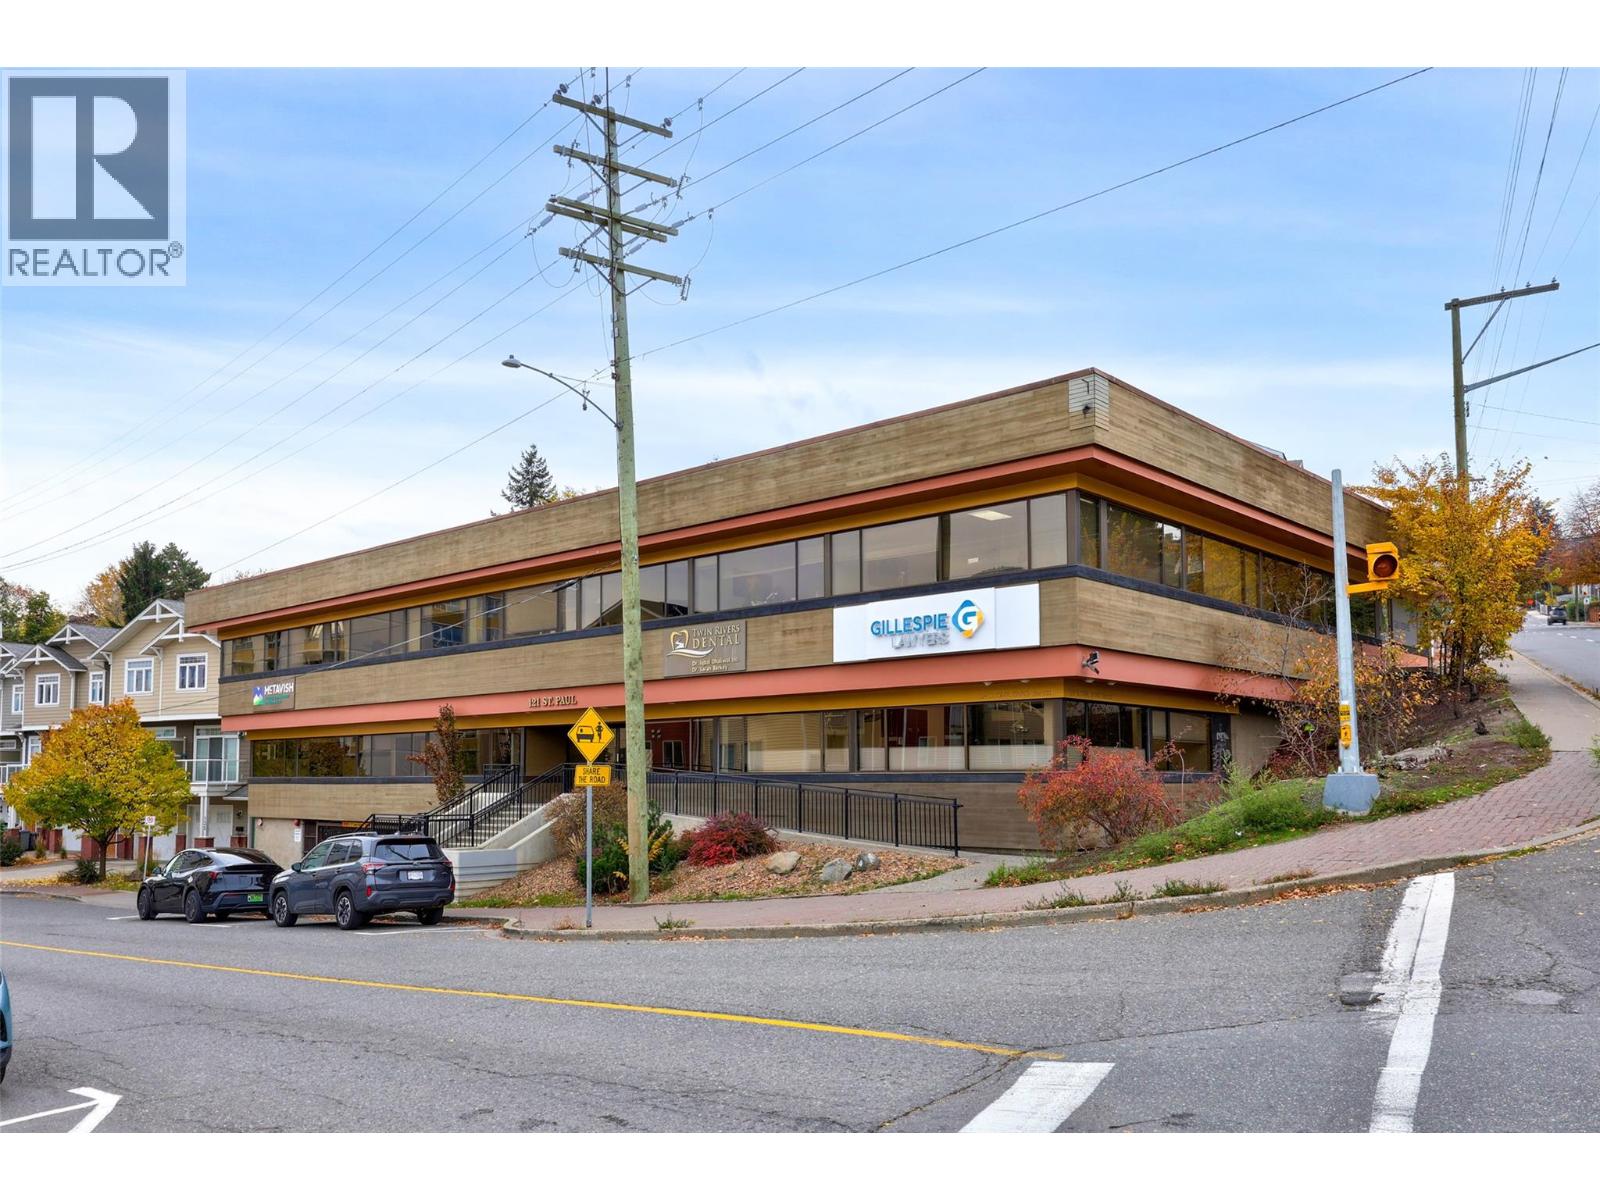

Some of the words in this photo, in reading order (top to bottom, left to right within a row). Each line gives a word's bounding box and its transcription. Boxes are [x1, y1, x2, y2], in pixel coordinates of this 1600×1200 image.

[692, 627, 713, 637] TWIN
[714, 624, 740, 635] RIVERS
[870, 612, 949, 636] GILLESPIE
[692, 633, 741, 649] DENTAL
[891, 632, 950, 650] LAWYERS
[528, 697, 541, 707] 121
[556, 695, 578, 705] PAUL
[582, 767, 601, 776] SHARE
[578, 775, 587, 784] THE
[589, 775, 606, 784] ROAD
